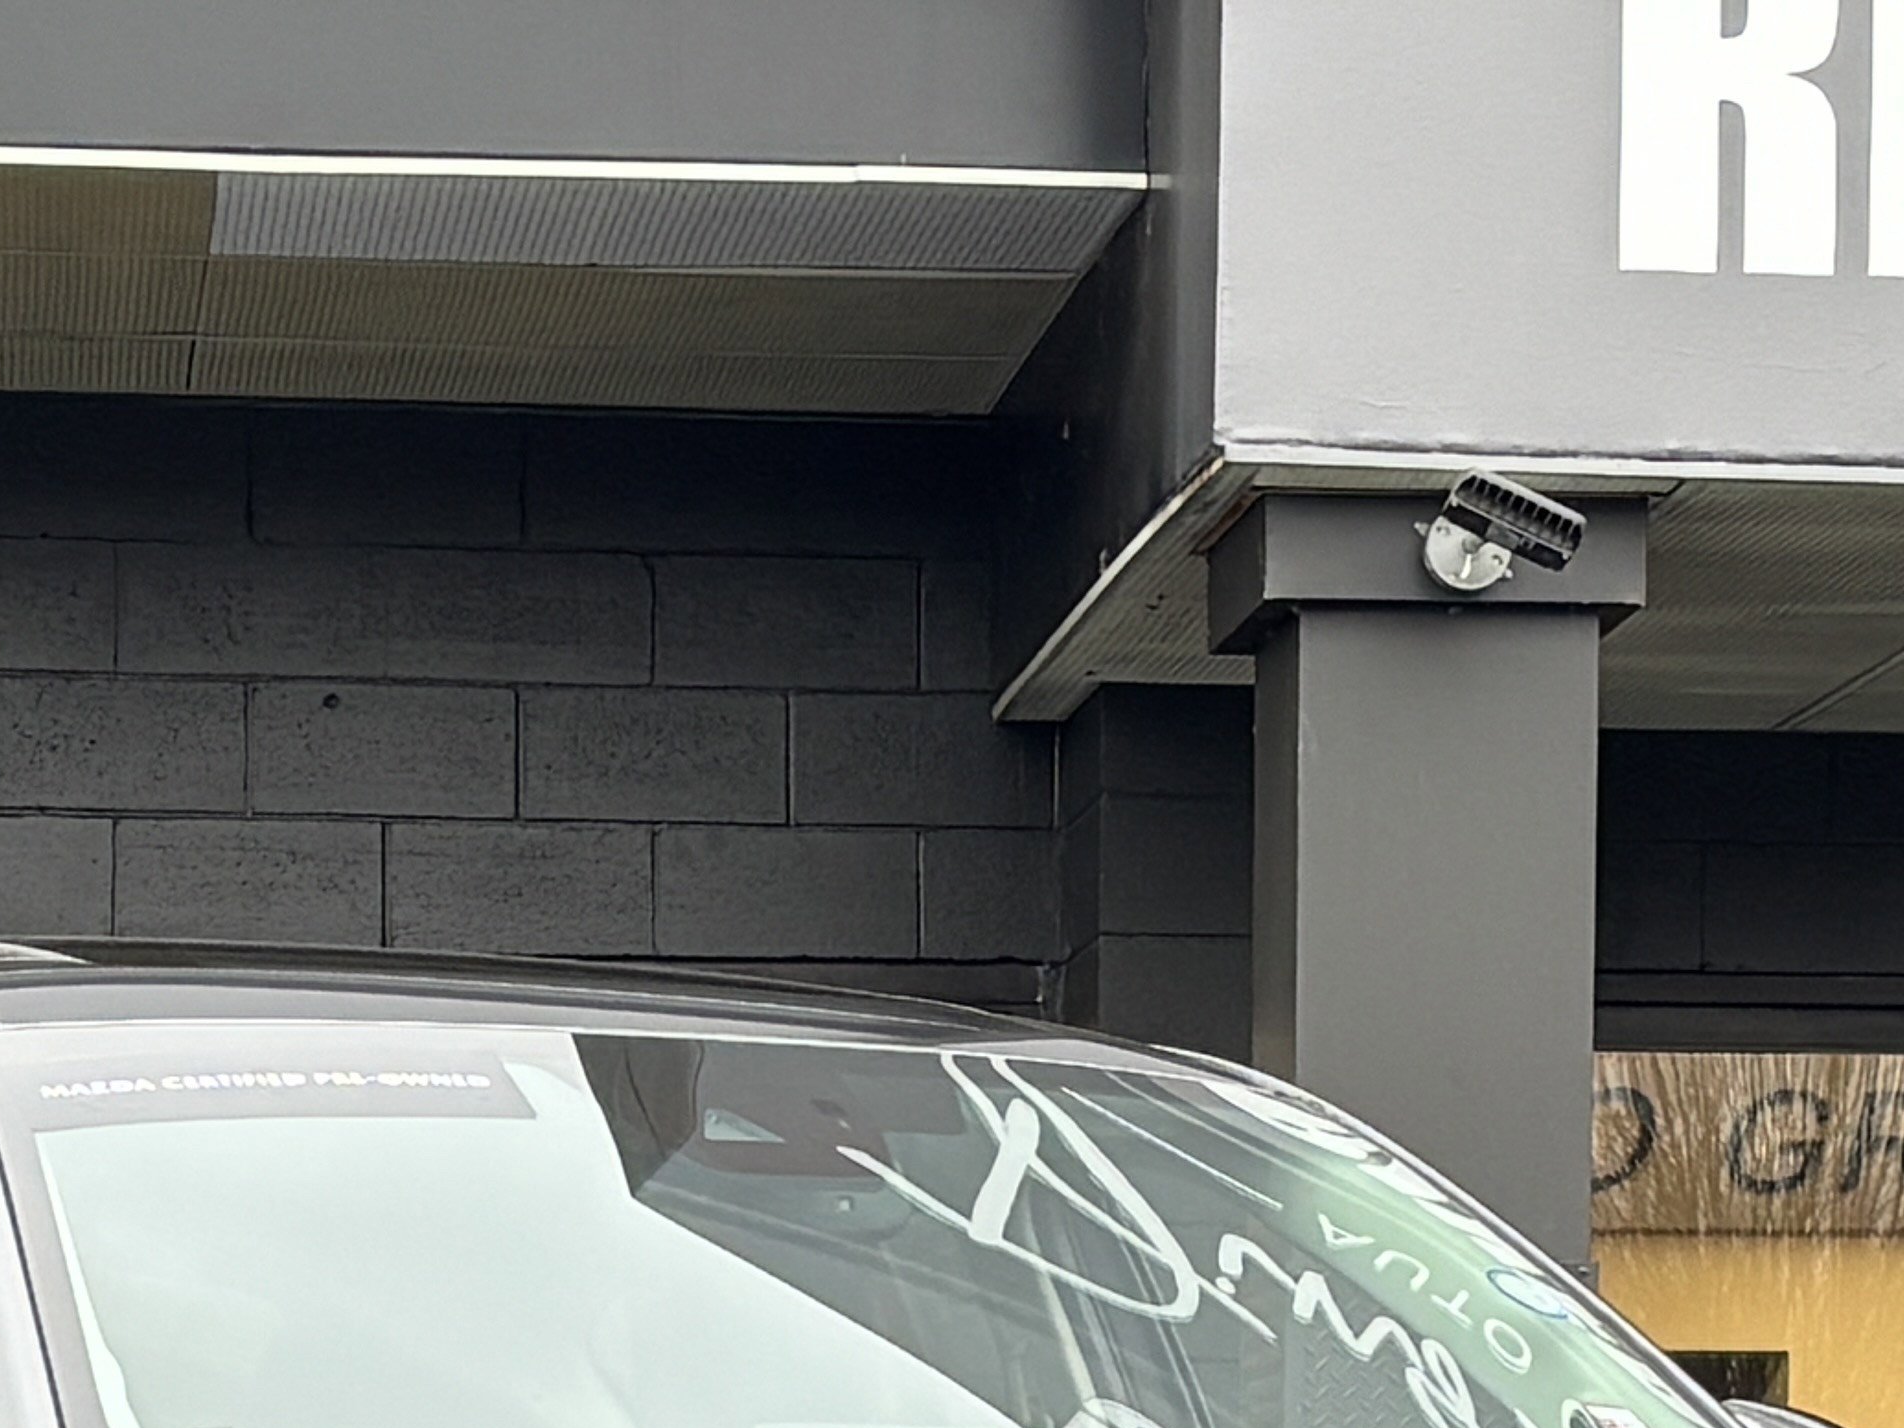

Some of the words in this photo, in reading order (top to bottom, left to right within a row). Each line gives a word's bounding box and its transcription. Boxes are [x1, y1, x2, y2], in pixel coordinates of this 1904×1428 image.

[39, 1078, 156, 1099] MAZDA
[161, 1072, 307, 1090] CERTIFIED
[313, 1071, 491, 1088] PRE-OWNED
